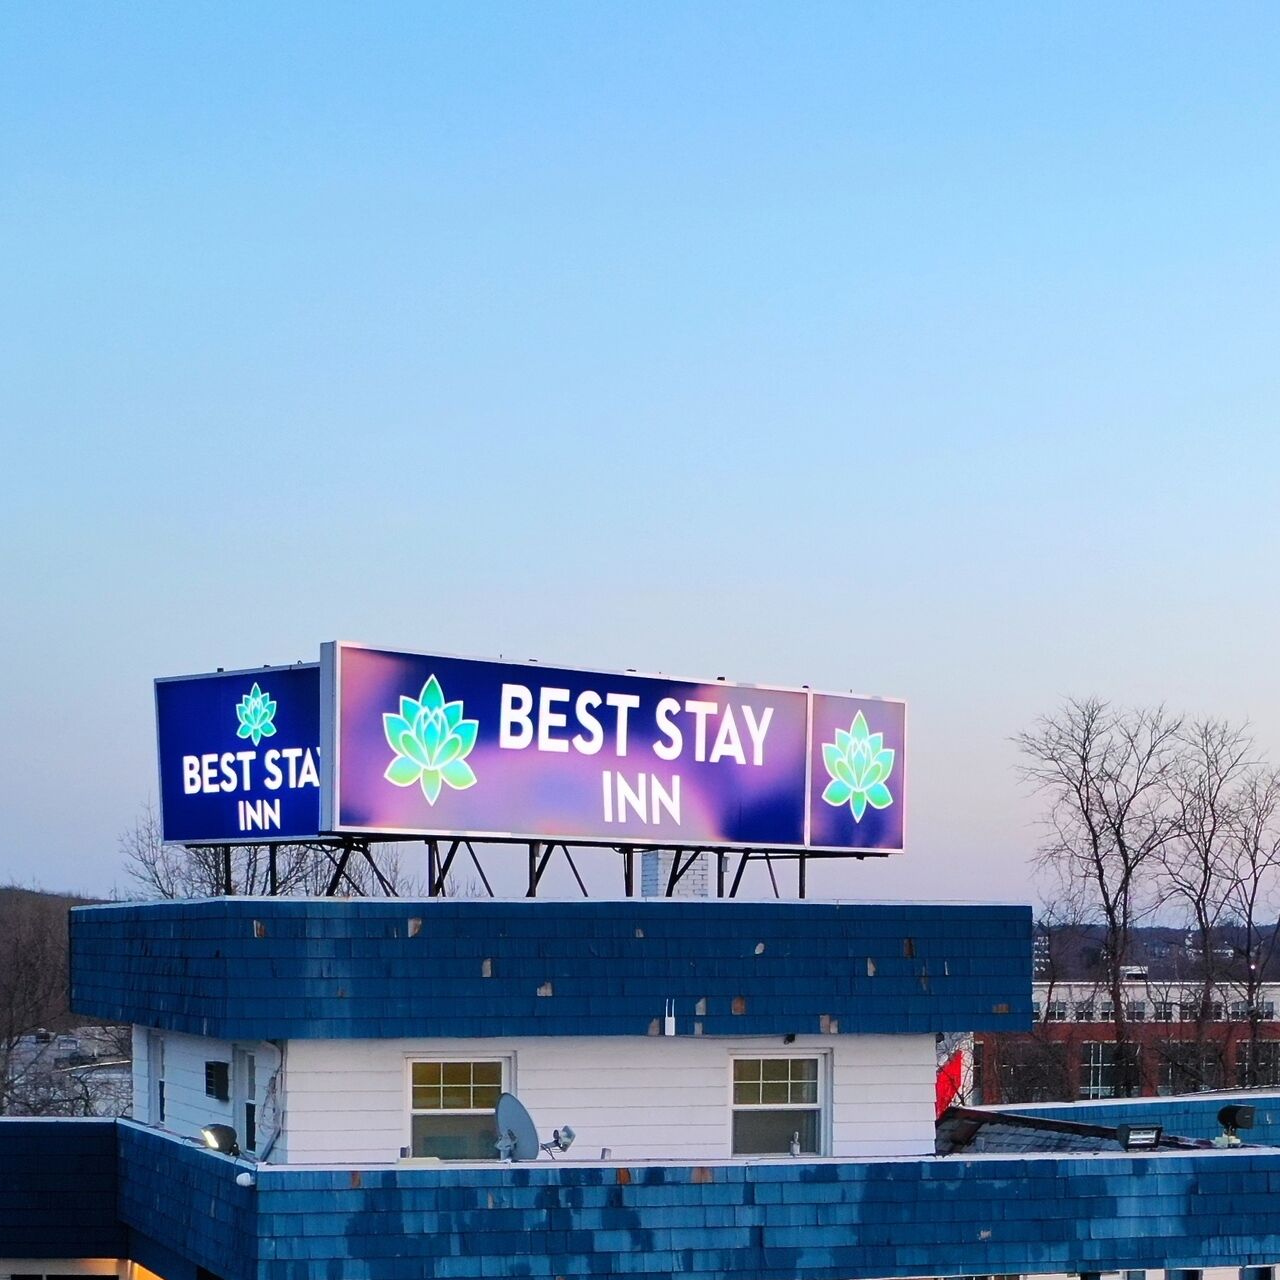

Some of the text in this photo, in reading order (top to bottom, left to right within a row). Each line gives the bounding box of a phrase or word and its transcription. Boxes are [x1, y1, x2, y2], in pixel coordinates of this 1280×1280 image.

[499, 683, 774, 766] BEST STAY
[183, 747, 320, 794] BEST STA
[238, 798, 281, 831] INN
[602, 770, 681, 826] INN
